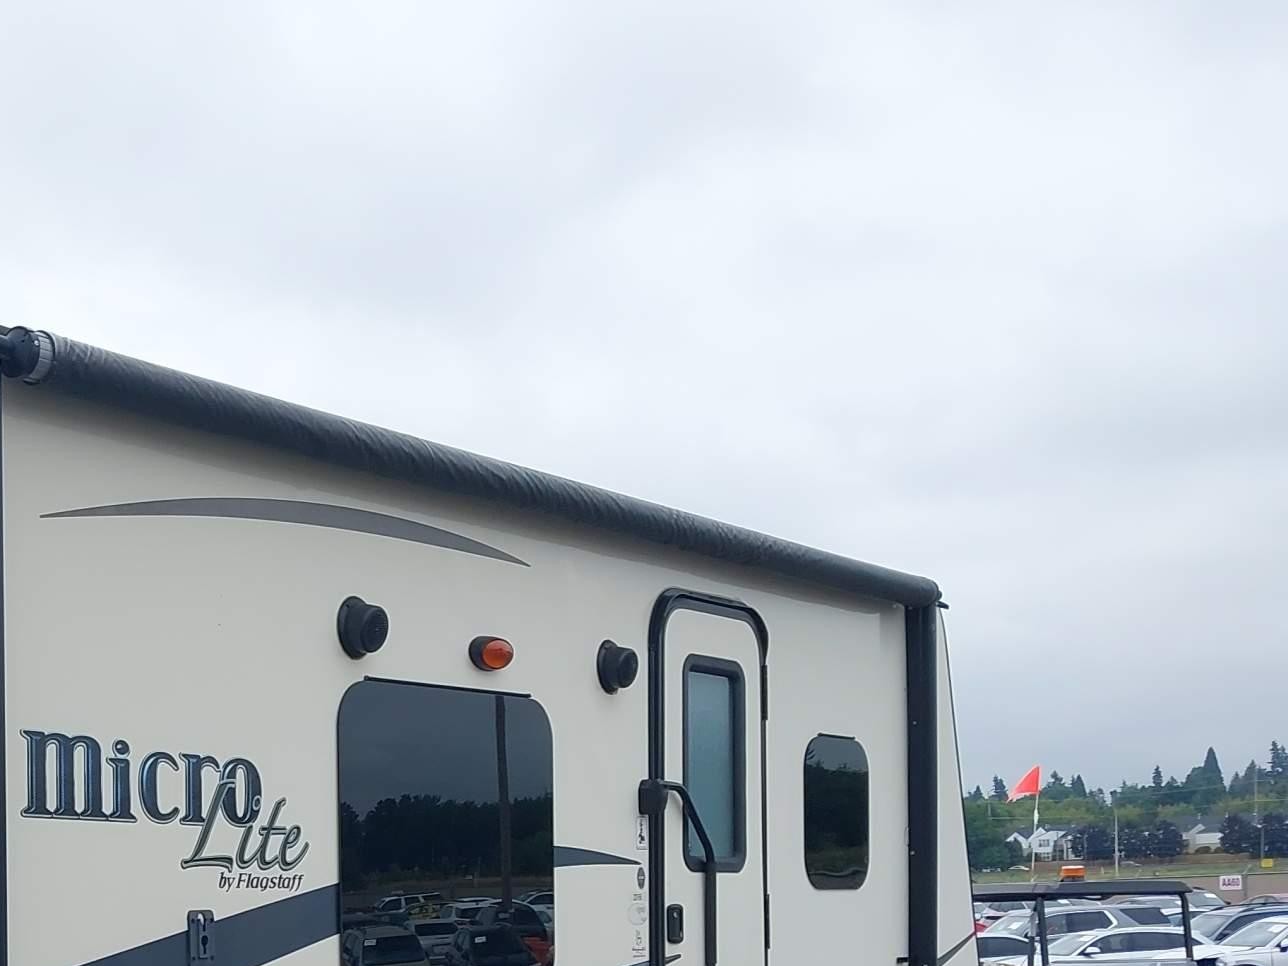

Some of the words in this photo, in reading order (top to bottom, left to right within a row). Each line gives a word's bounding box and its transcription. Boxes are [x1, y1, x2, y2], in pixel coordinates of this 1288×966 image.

[19, 728, 262, 827] micro
[180, 779, 310, 873] Lite
[218, 872, 235, 890] by
[235, 873, 304, 892] Flagstaff
